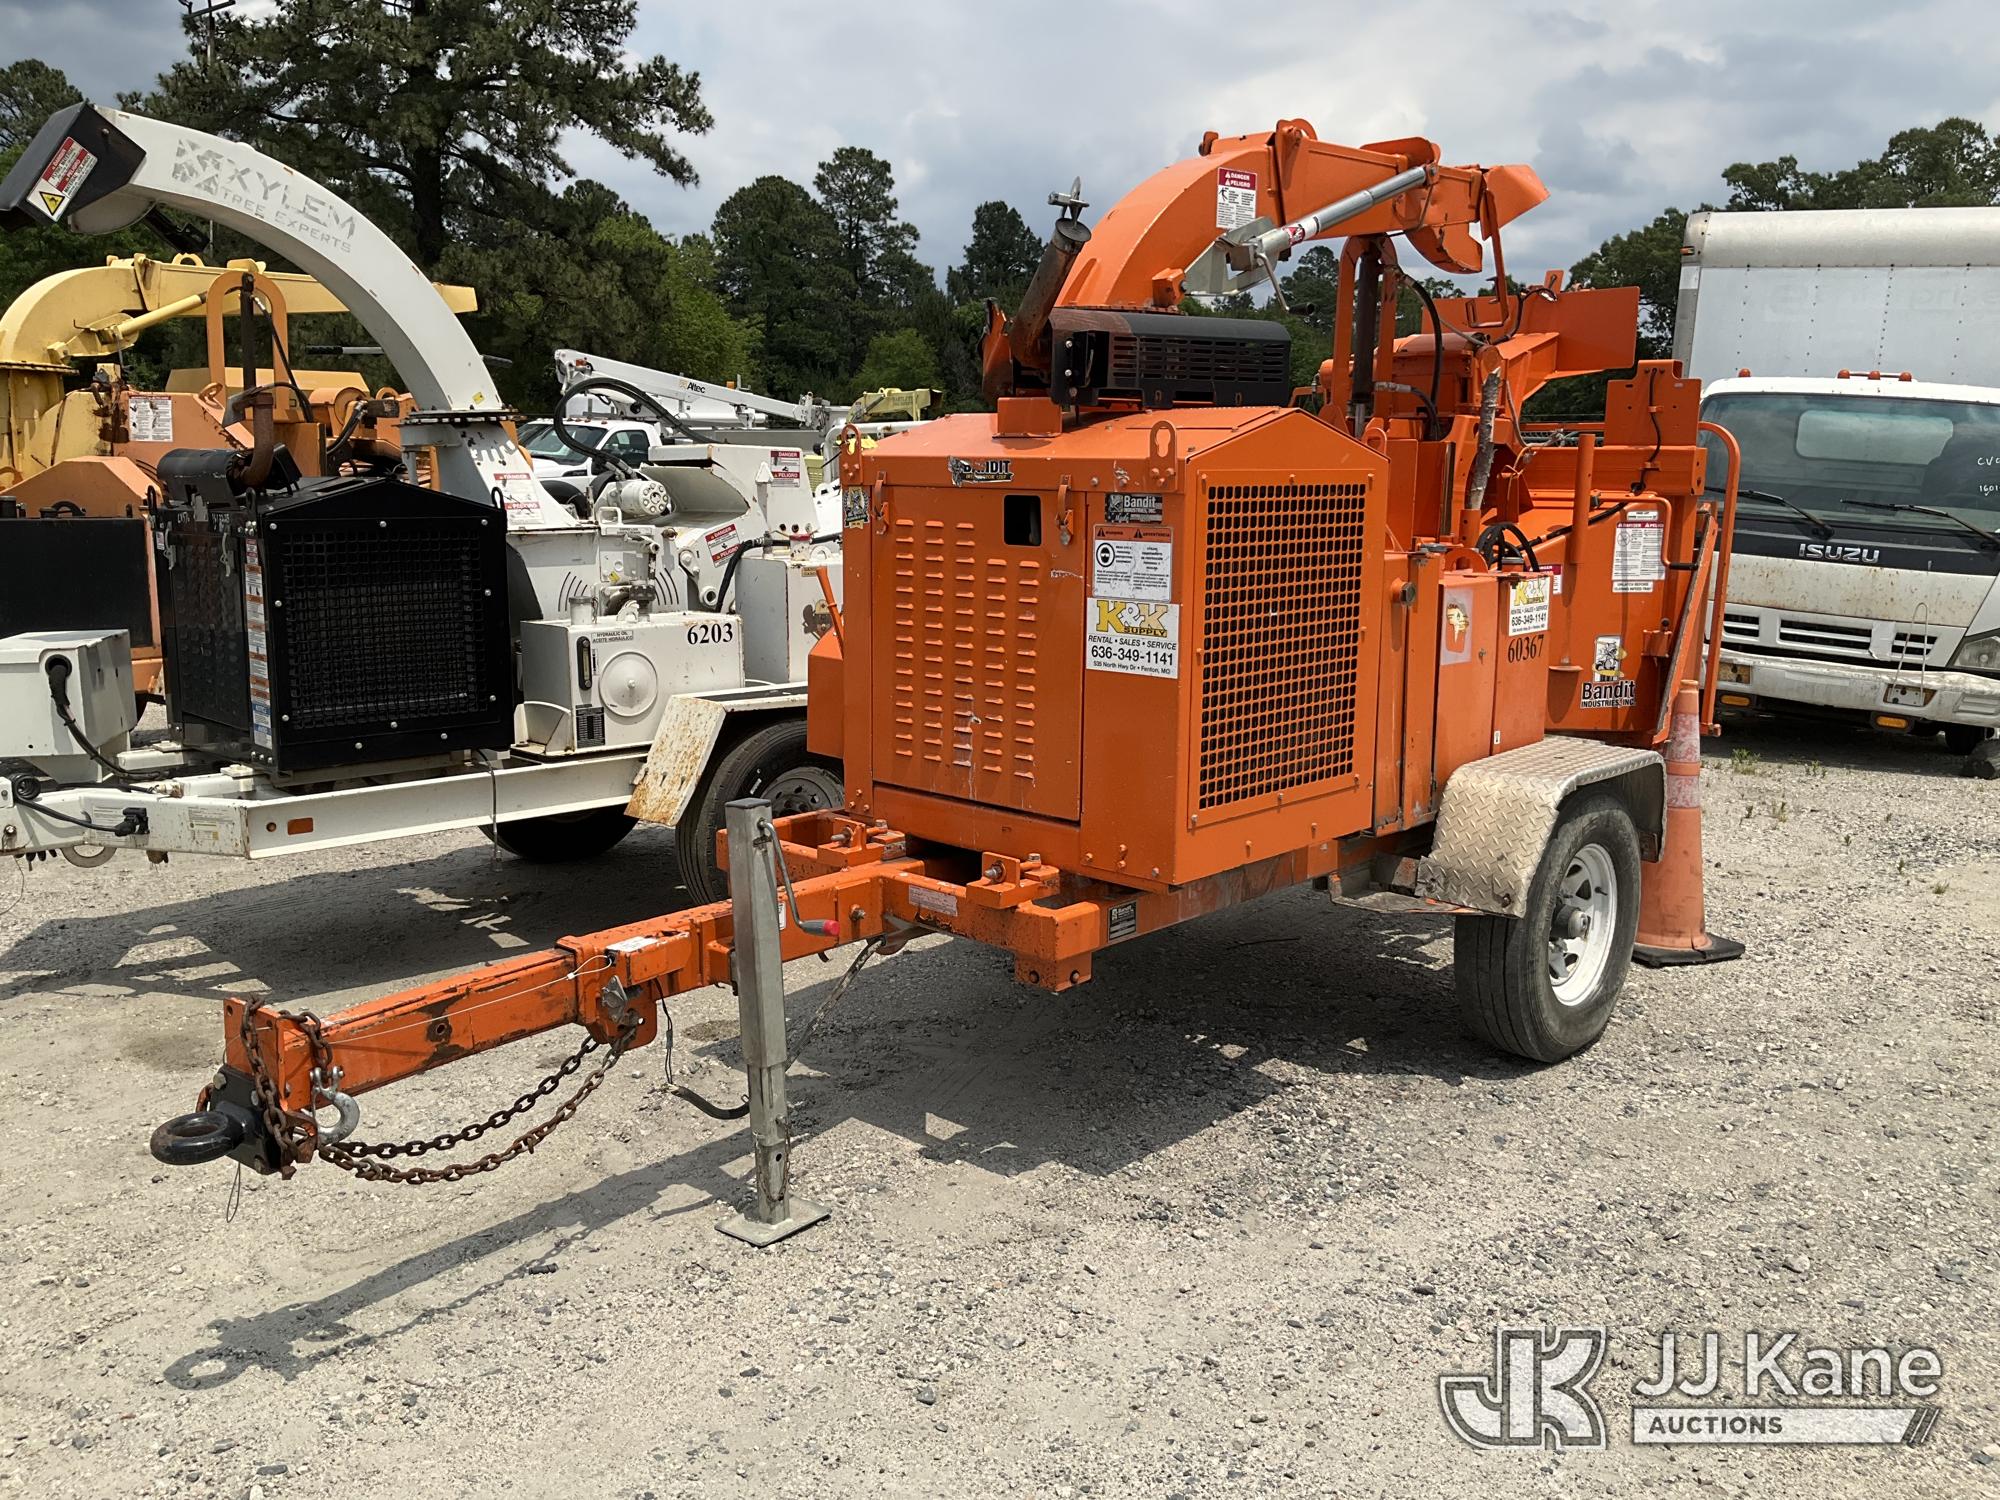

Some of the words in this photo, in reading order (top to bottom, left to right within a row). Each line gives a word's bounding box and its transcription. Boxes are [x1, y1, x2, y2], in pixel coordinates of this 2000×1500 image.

[1230, 172, 1250, 180] DANGER
[1230, 180, 1251, 188] PELIGRO
[220, 186, 266, 217] TREE
[274, 211, 352, 253] EXPERTS
[686, 381, 706, 394] Altec
[1979, 484, 2000, 492] 1601
[1123, 495, 1156, 508] Bandit
[1798, 543, 1880, 564] ISUZU
[1096, 599, 1169, 633] K&K
[1511, 612, 1547, 627] 636-349-1141
[687, 622, 733, 645] 6203
[1123, 626, 1168, 638] SUPPLY
[1088, 634, 1113, 644] RENTAL
[1119, 637, 1141, 647] SALES
[1146, 640, 1177, 650] SERVICE
[1507, 634, 1545, 663] 60367
[1091, 645, 1173, 666] 636-349-1141
[1141, 665, 1160, 674] Fenton,
[1582, 680, 1635, 700] Bandit
